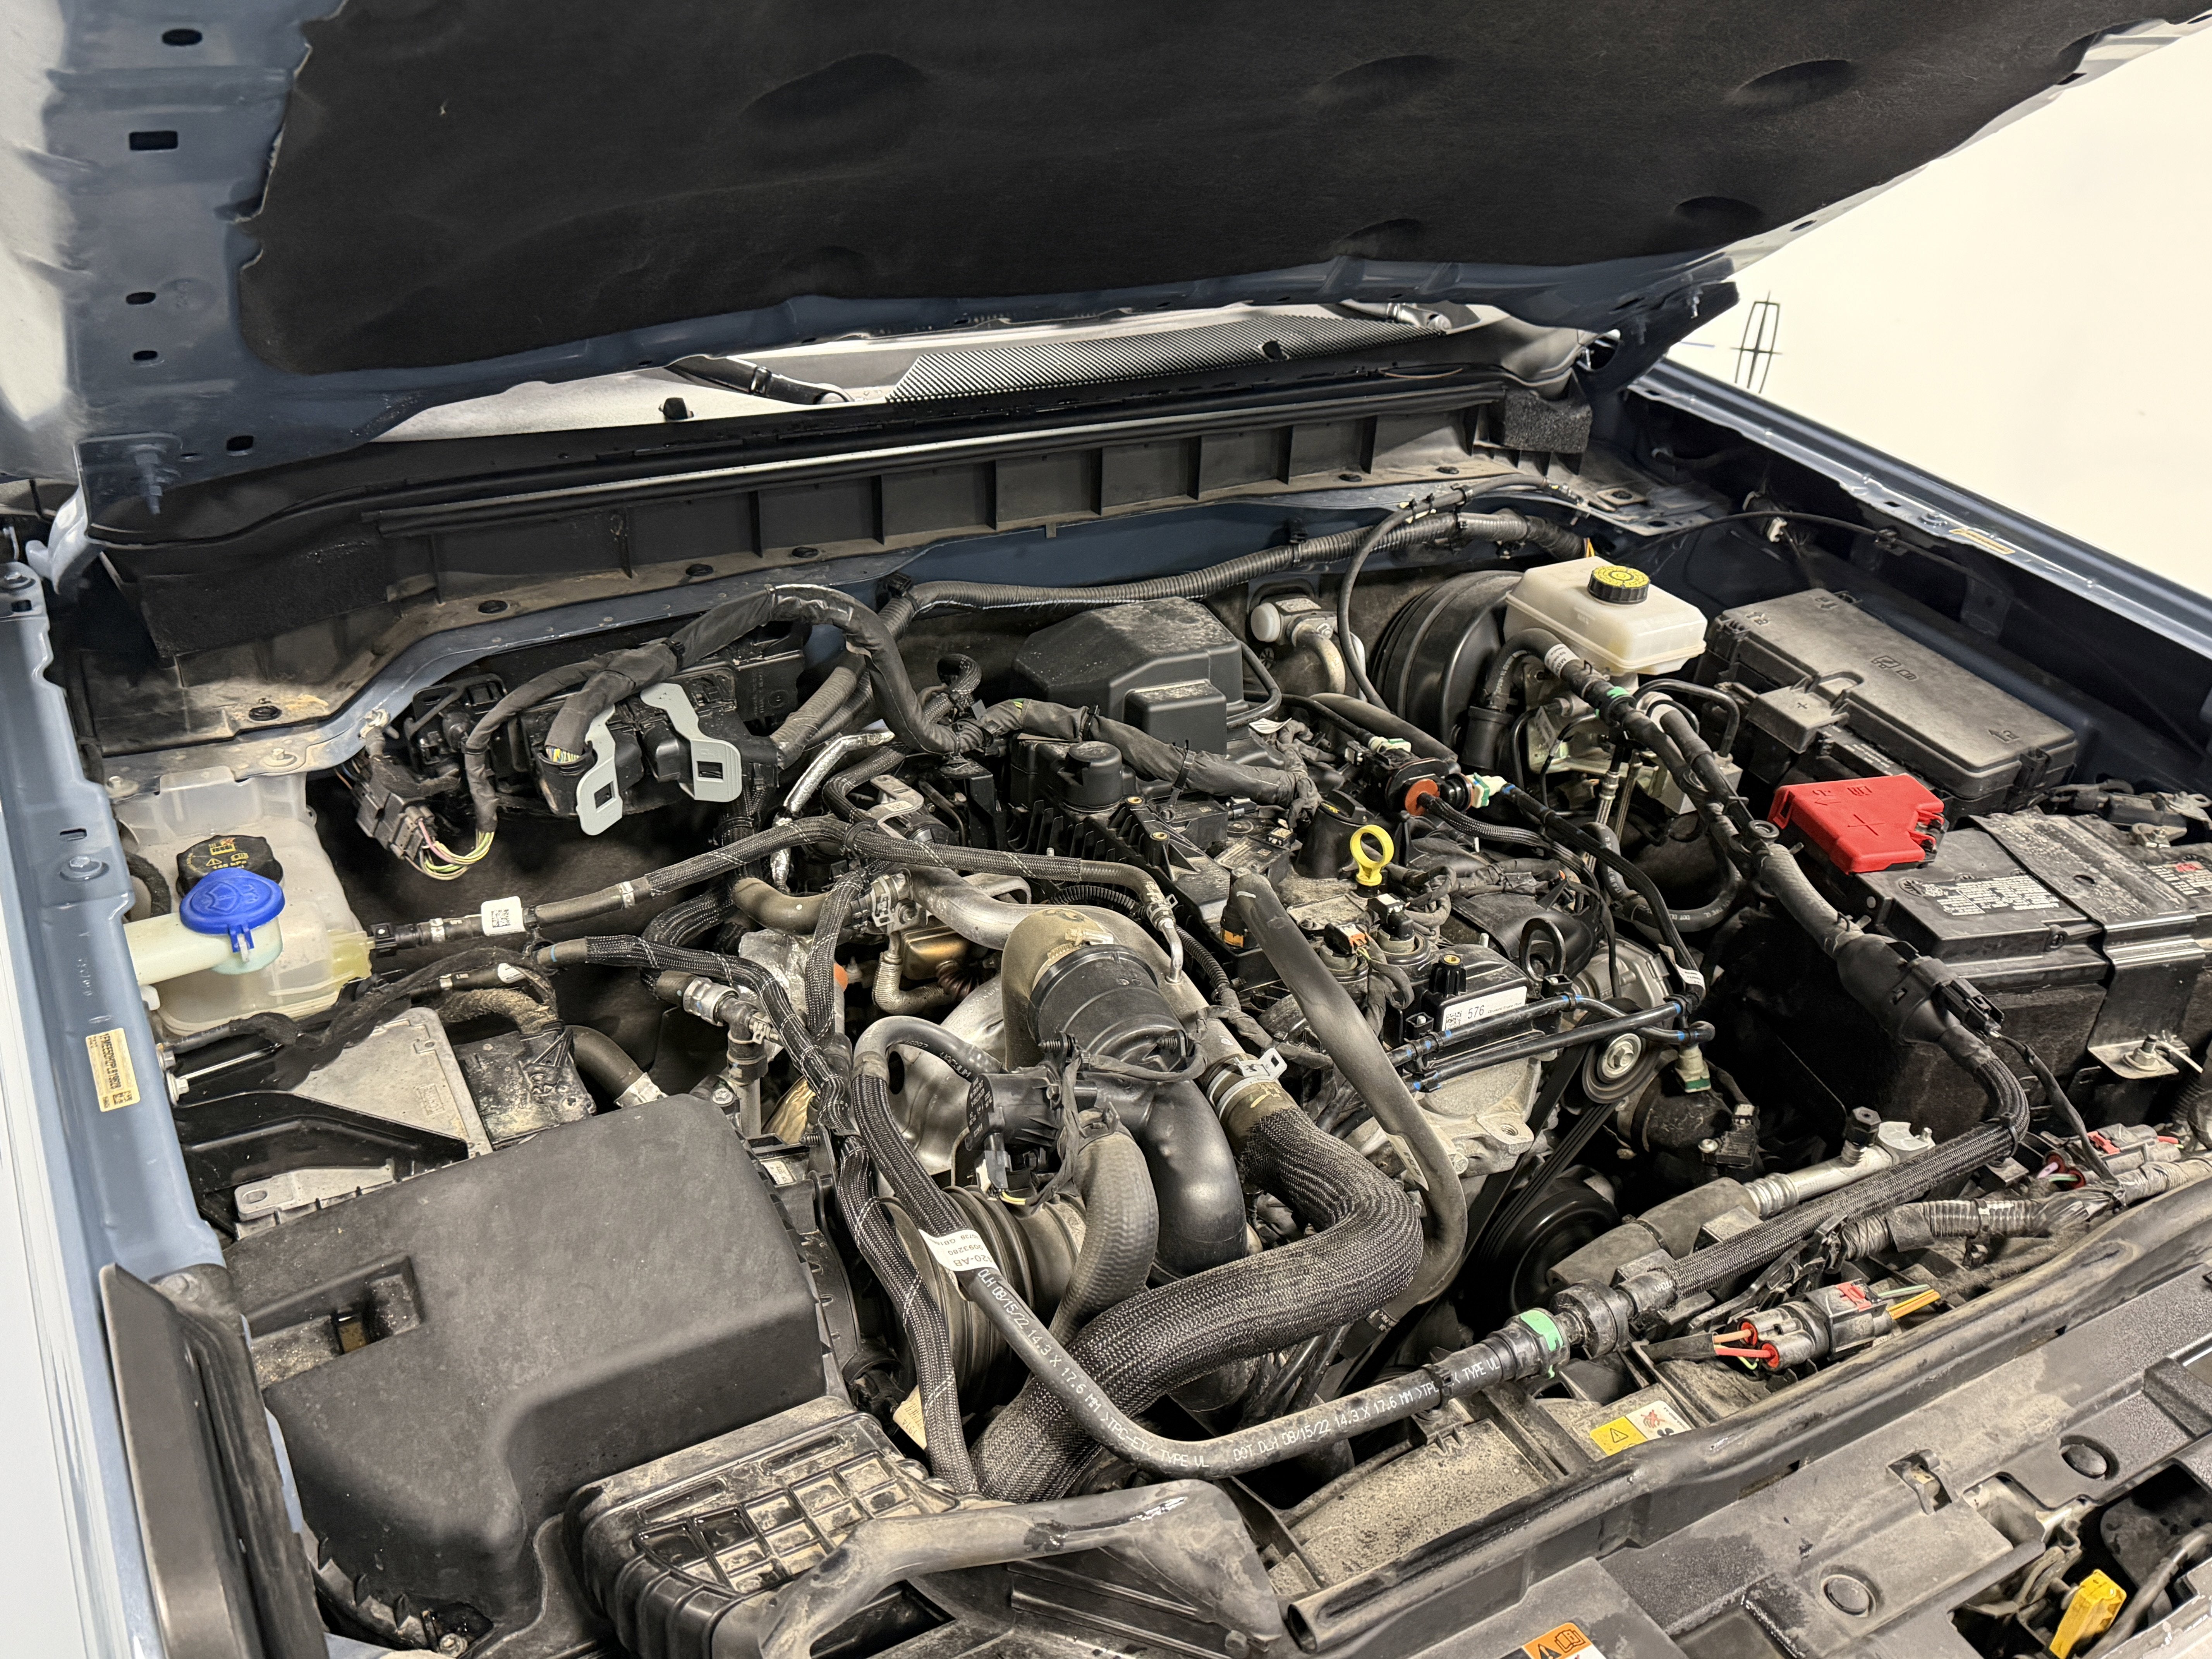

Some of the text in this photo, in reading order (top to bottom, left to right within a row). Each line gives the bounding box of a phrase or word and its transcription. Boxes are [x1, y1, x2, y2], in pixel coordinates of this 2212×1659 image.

[1467, 1005, 1485, 1019] 576
[992, 1286, 1029, 1329] 08/15/22
[1027, 1329, 1052, 1355] 14.3
[1049, 1355, 1062, 1367] X
[1061, 1367, 1086, 1394] 17.6
[1085, 1393, 1102, 1413] MM
[1161, 1449, 1188, 1467] TYPE
[1194, 1455, 1209, 1468] VL
[1233, 1444, 1253, 1462] DOT
[1281, 1419, 1331, 1446] 08/15/22
[1334, 1409, 1359, 1428] 14.3
[1361, 1406, 1371, 1419] X
[1374, 1396, 1397, 1414] 17.6
[1399, 1390, 1413, 1405] MM
[1462, 1361, 1486, 1381] TYPE
[1486, 1357, 1501, 1371] VL
